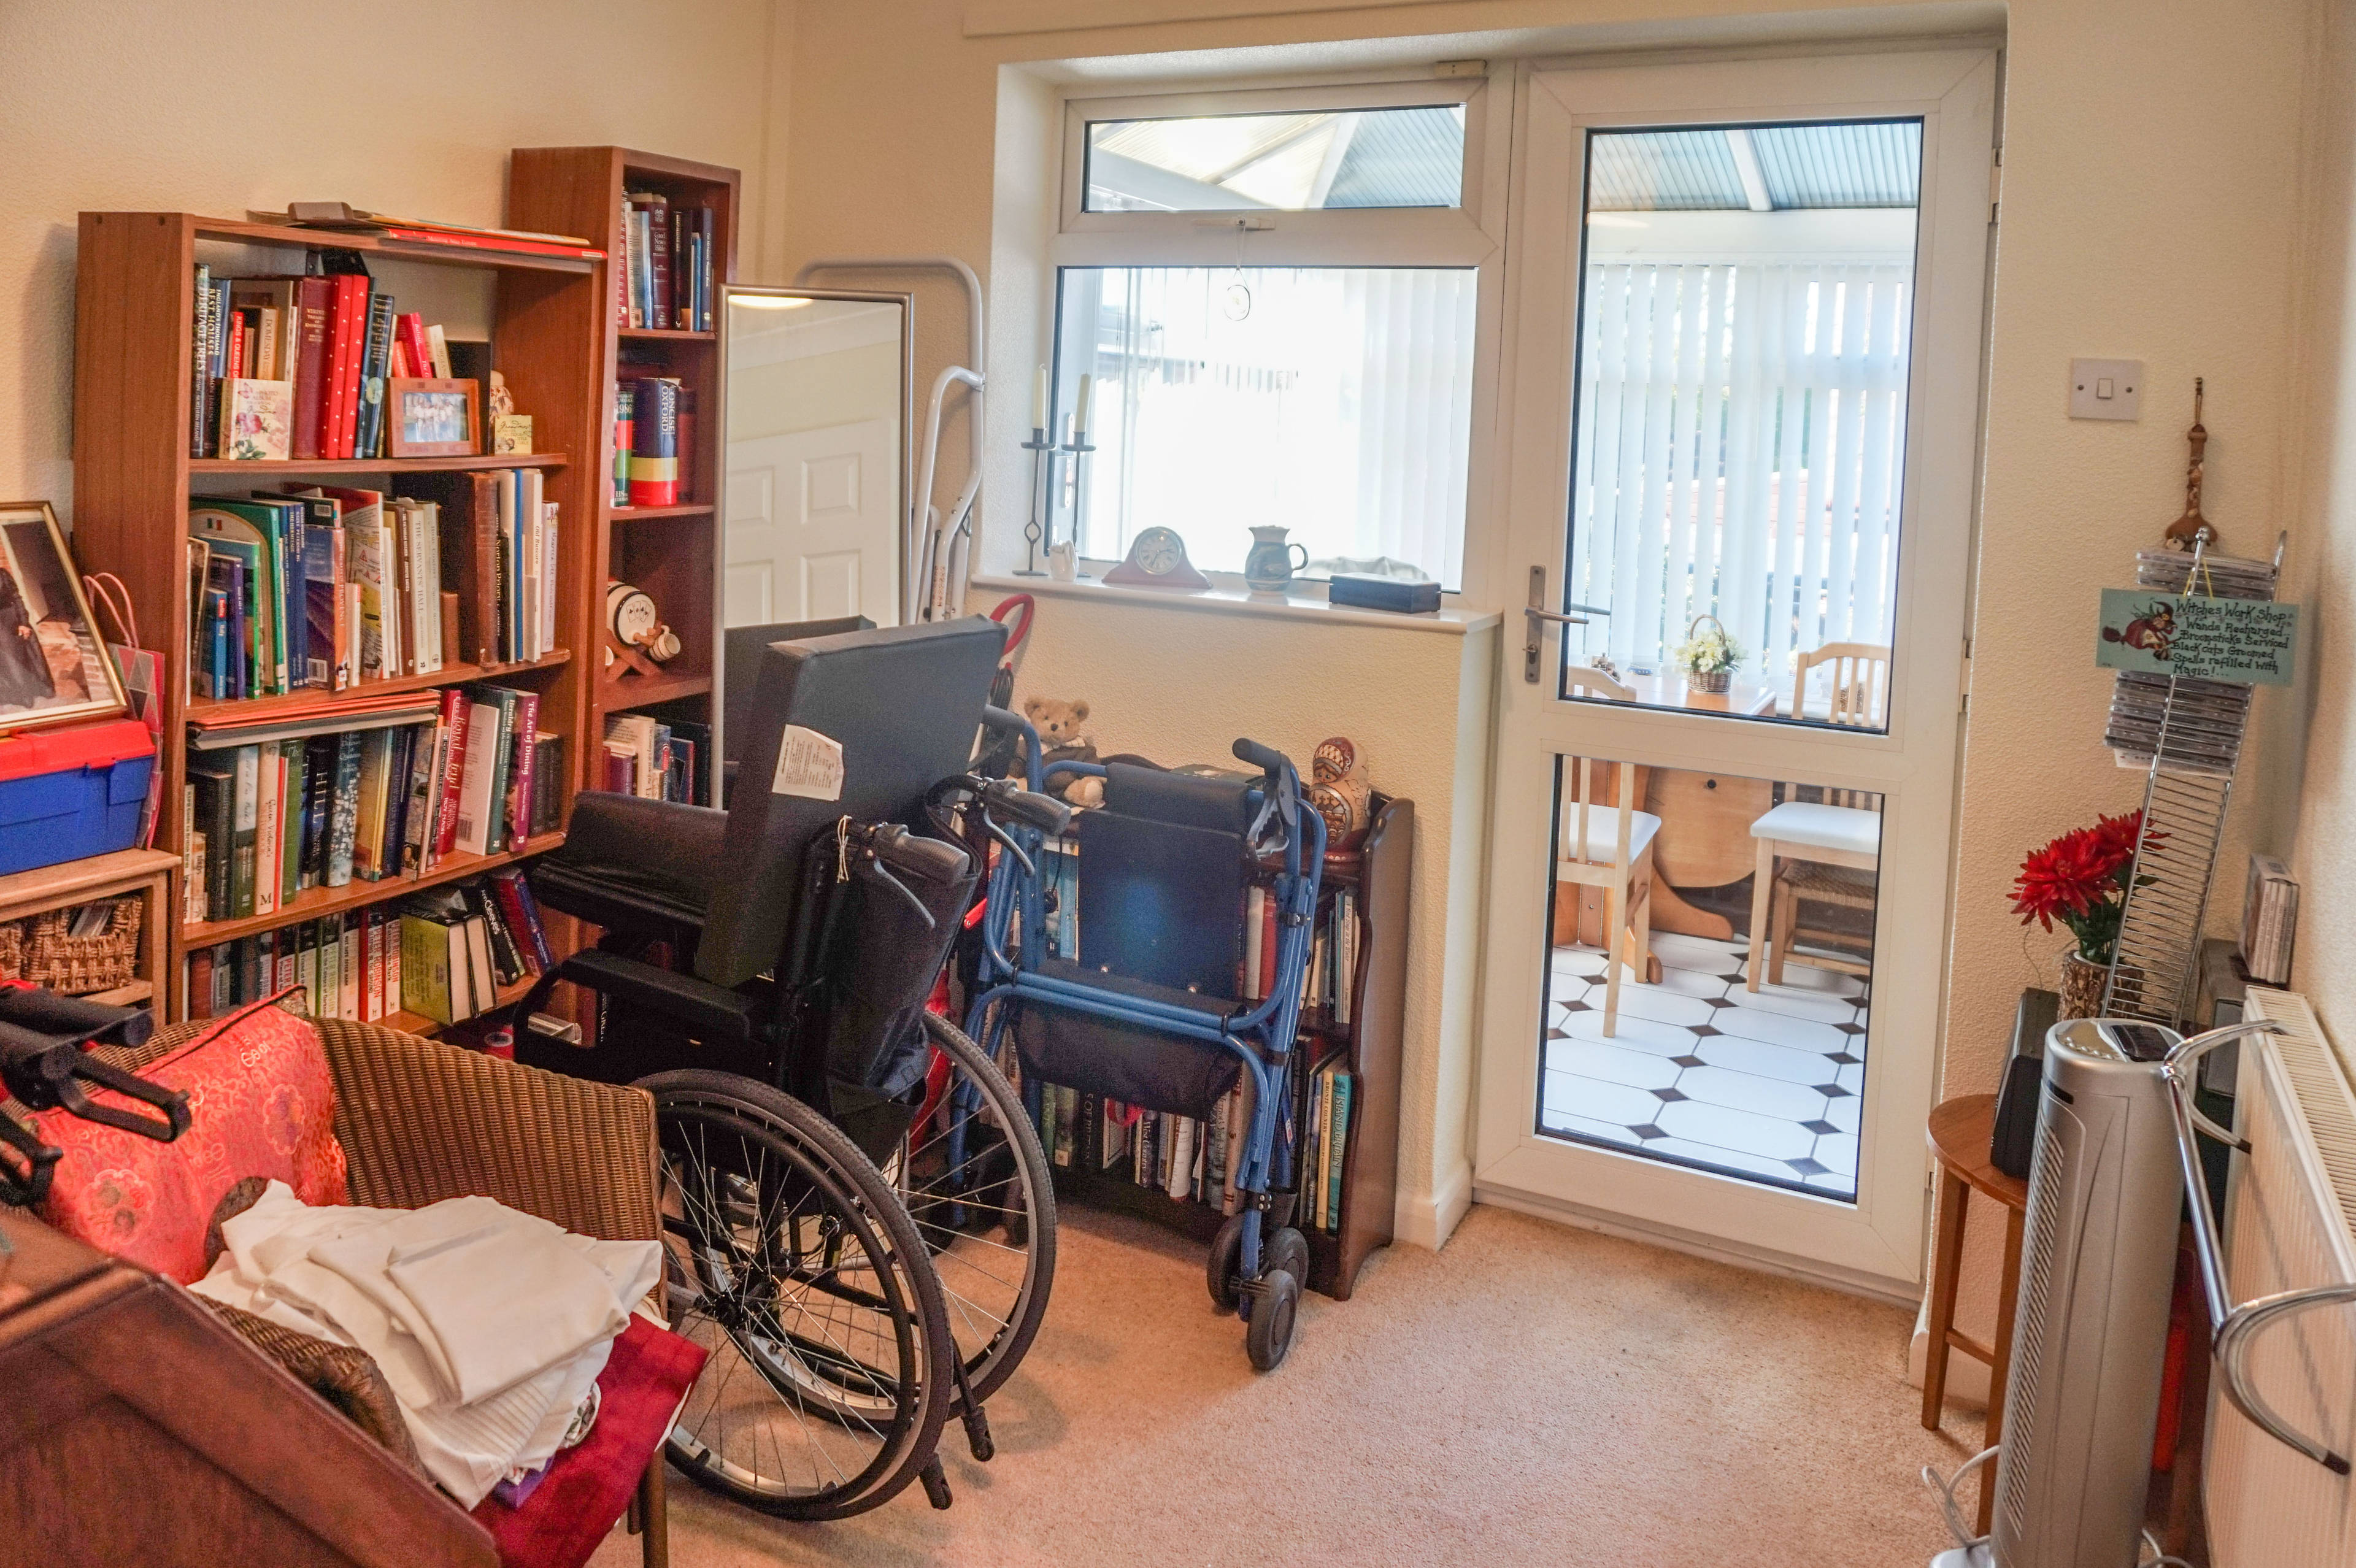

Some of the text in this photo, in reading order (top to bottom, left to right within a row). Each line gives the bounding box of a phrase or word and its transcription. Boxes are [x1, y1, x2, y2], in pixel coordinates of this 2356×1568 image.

[264, 319, 272, 360] DOMESDAY
[196, 342, 206, 371] TREES
[2176, 599, 2222, 618] Witches
[2225, 602, 2255, 623] Work
[2186, 617, 2220, 631] Wands
[2171, 642, 2201, 655] Black
[2228, 647, 2276, 659] Groomed
[2180, 630, 2289, 648] Broomsticks Serviced
[2173, 653, 2279, 674] Spells refilled with
[506, 700, 515, 732] Heraldry
[452, 717, 466, 750] Royal
[525, 735, 533, 744] of
[522, 746, 531, 775] Dining
[312, 772, 327, 823] HILL
[260, 894, 271, 906] M
[484, 899, 500, 934] Cleeves
[1141, 1121, 1151, 1170] West Country
[1333, 1096, 1345, 1168] ISLAND BRITAIN
